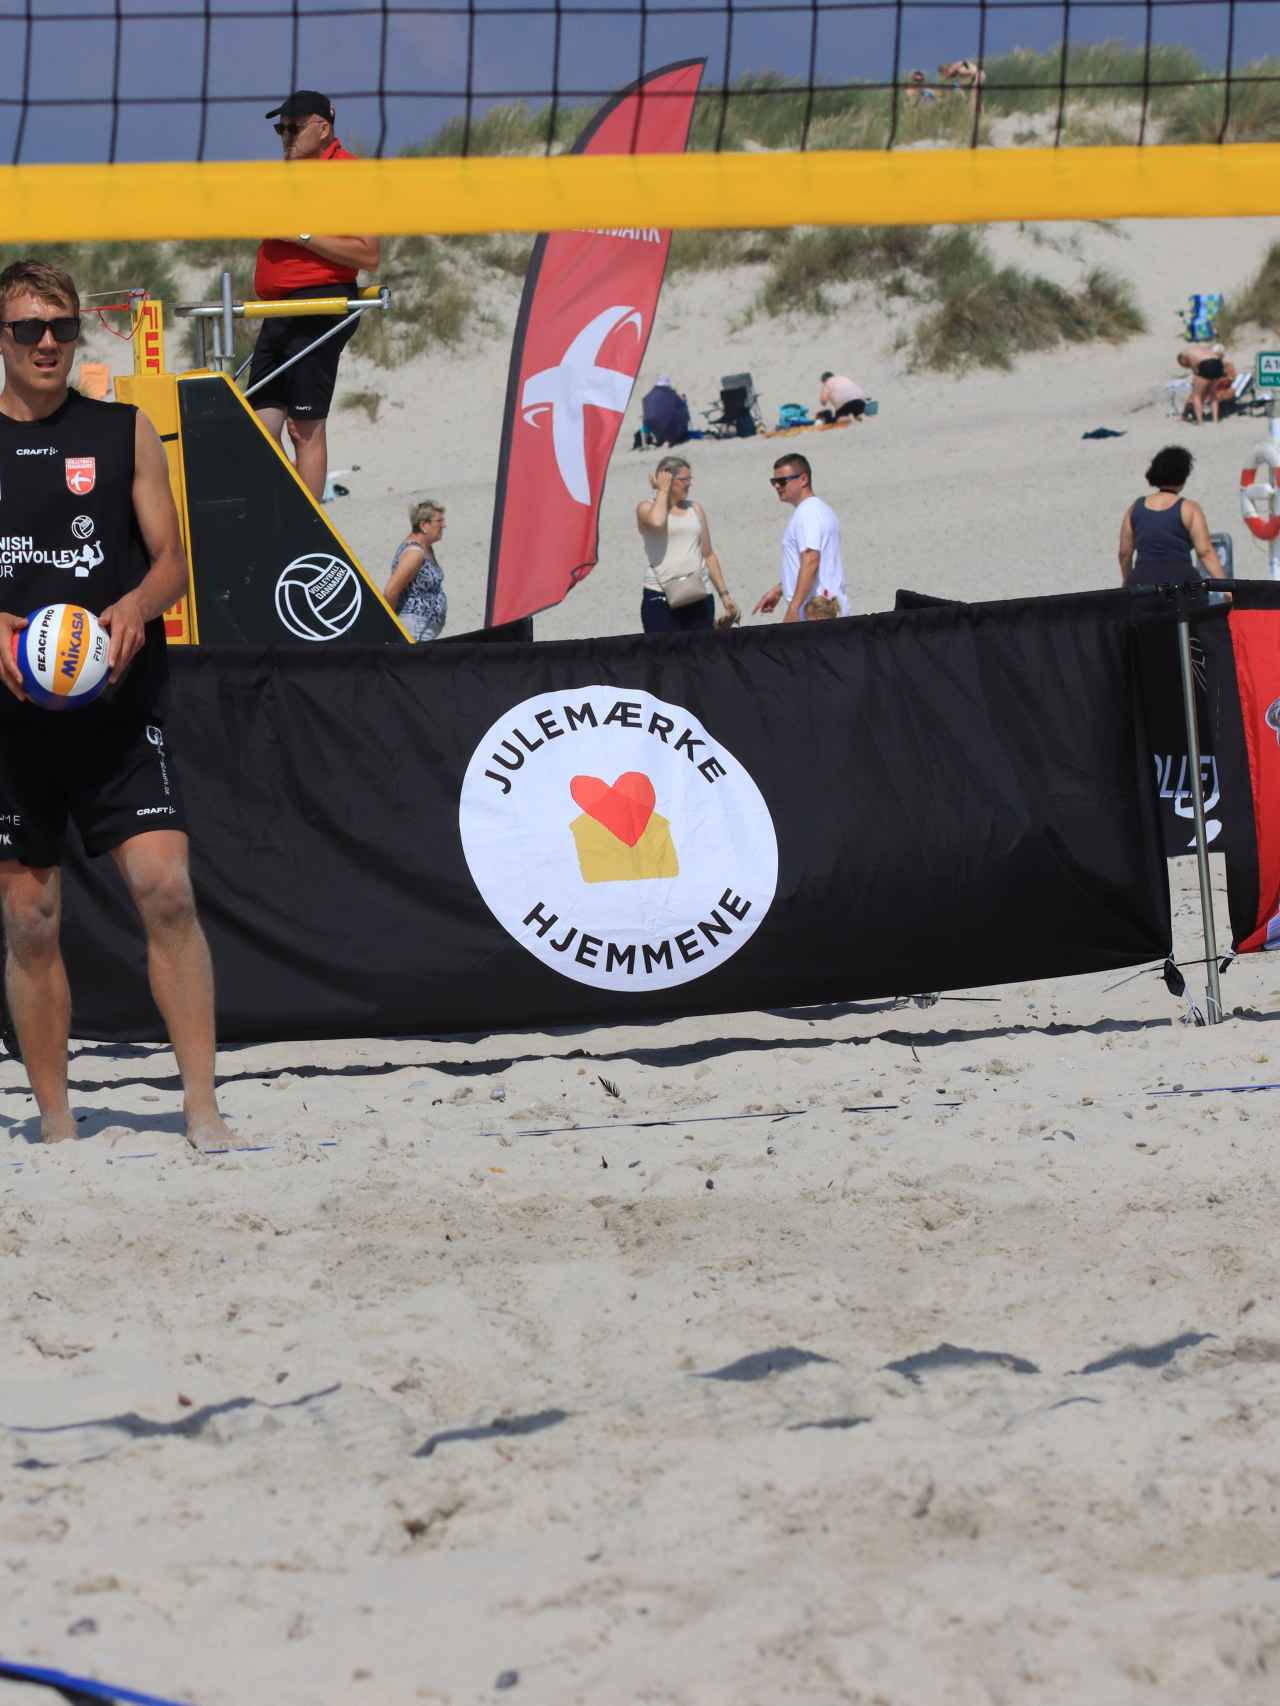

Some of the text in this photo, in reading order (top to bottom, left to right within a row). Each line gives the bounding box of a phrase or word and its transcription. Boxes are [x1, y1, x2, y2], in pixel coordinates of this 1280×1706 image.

[15, 448, 49, 456] CRAFT
[315, 568, 347, 600] DANMARK
[37, 609, 55, 672] BEACH PRO
[484, 700, 727, 795] JULEMÆRKE
[136, 806, 169, 816] CRAFT
[522, 887, 752, 975] HJEMMENE
